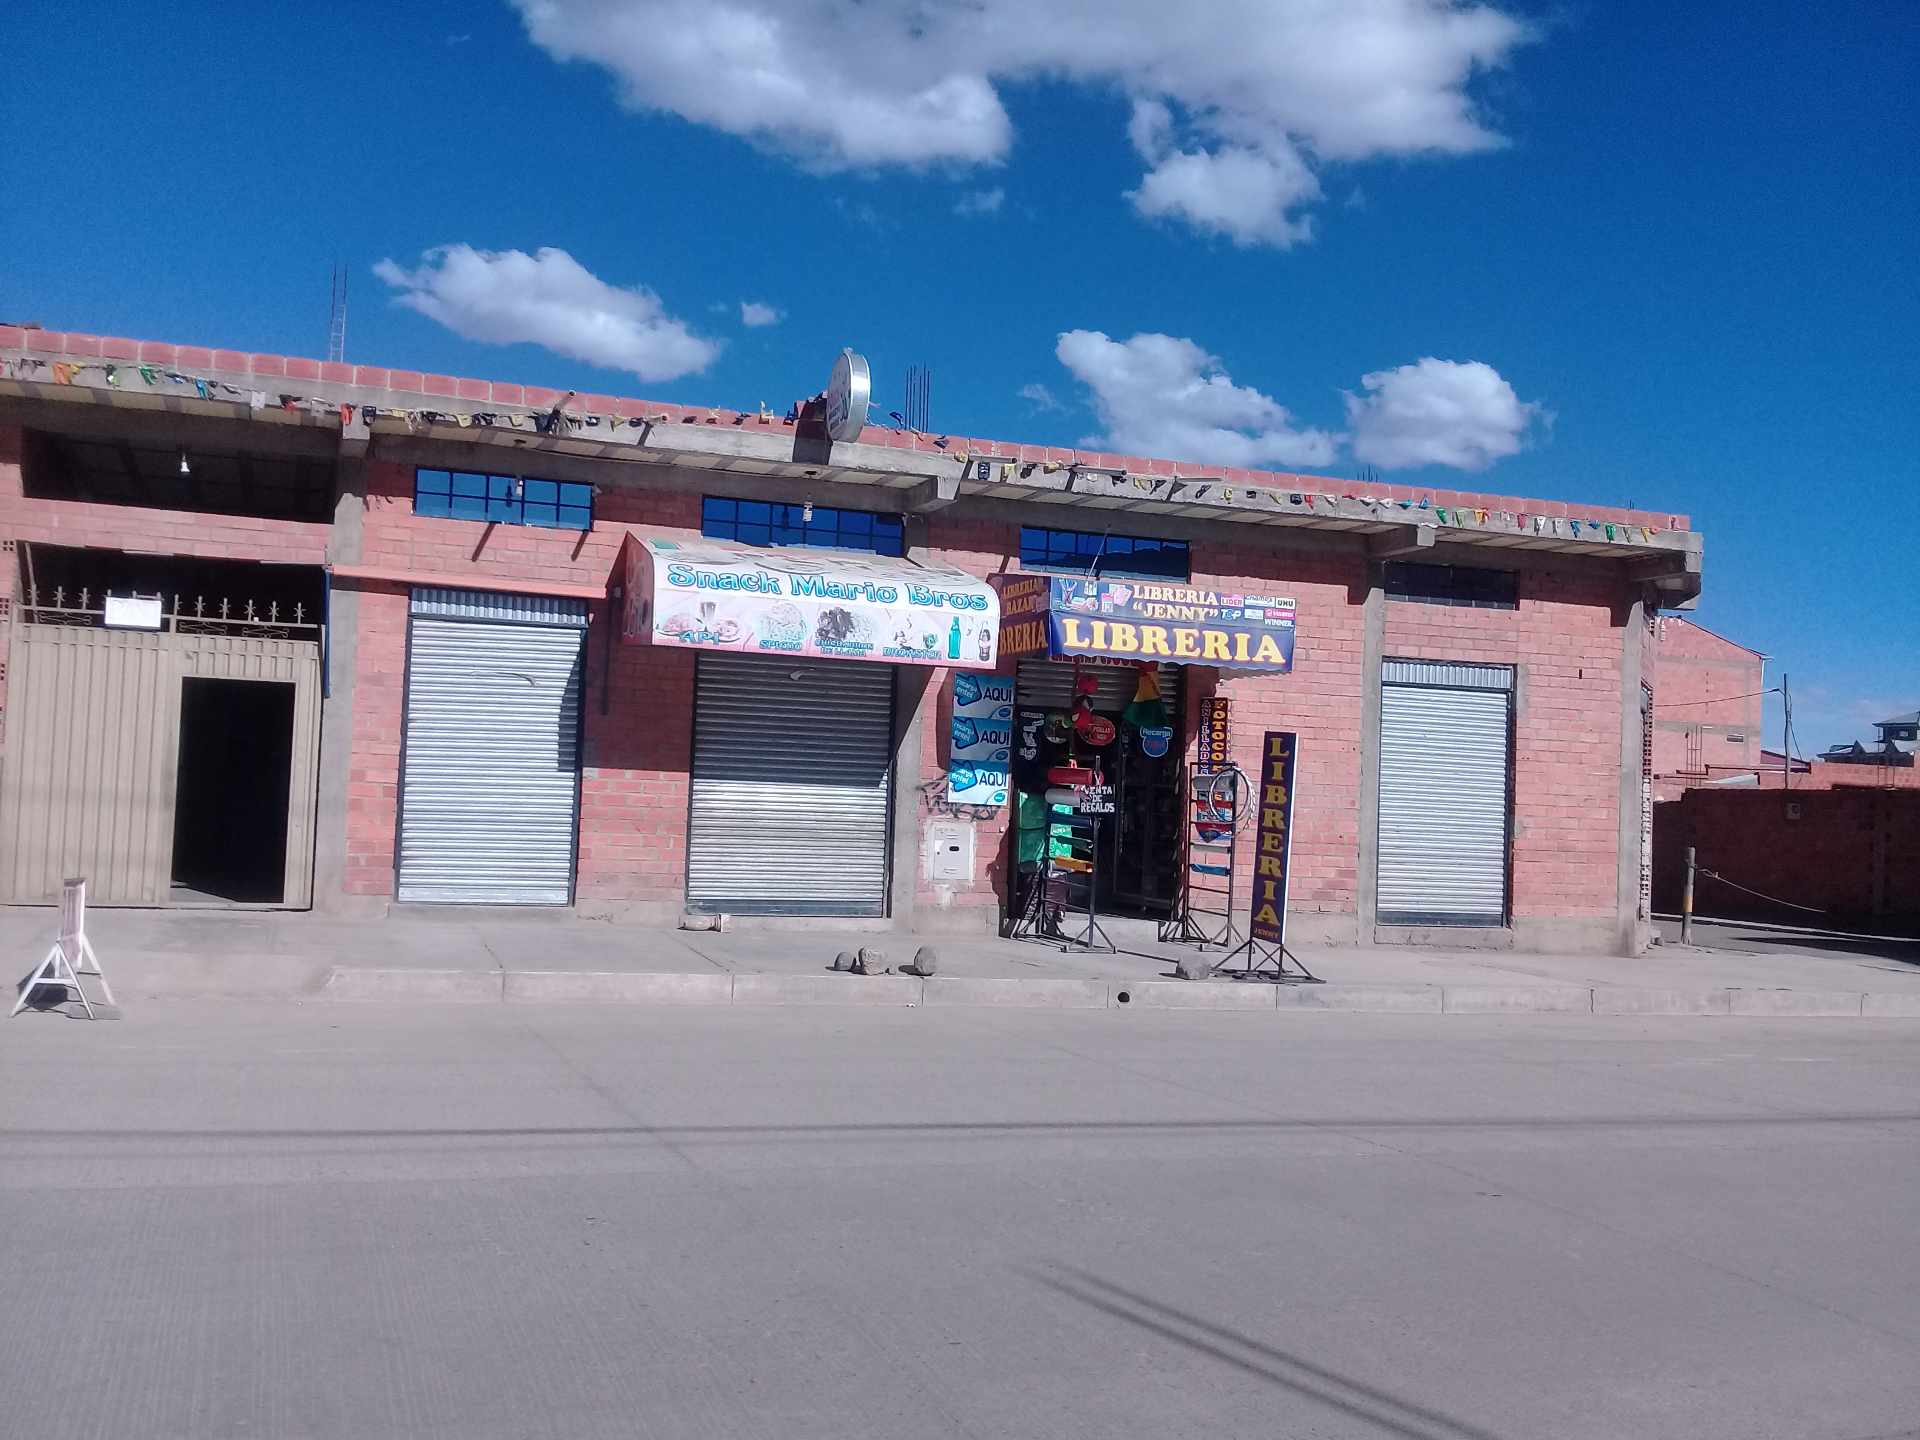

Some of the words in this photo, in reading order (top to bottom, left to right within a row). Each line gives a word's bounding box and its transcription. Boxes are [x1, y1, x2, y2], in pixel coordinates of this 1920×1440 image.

[668, 563, 782, 595] Snack
[788, 574, 898, 603] Mario
[906, 583, 988, 610] Bros
[1132, 585, 1219, 606] LIBRERIA
[1062, 618, 1286, 664] LIBRERIA
[1080, 785, 1113, 795] VENTA
[1080, 803, 1115, 813] REGALOS
[1253, 737, 1289, 927] LIBRERIA
